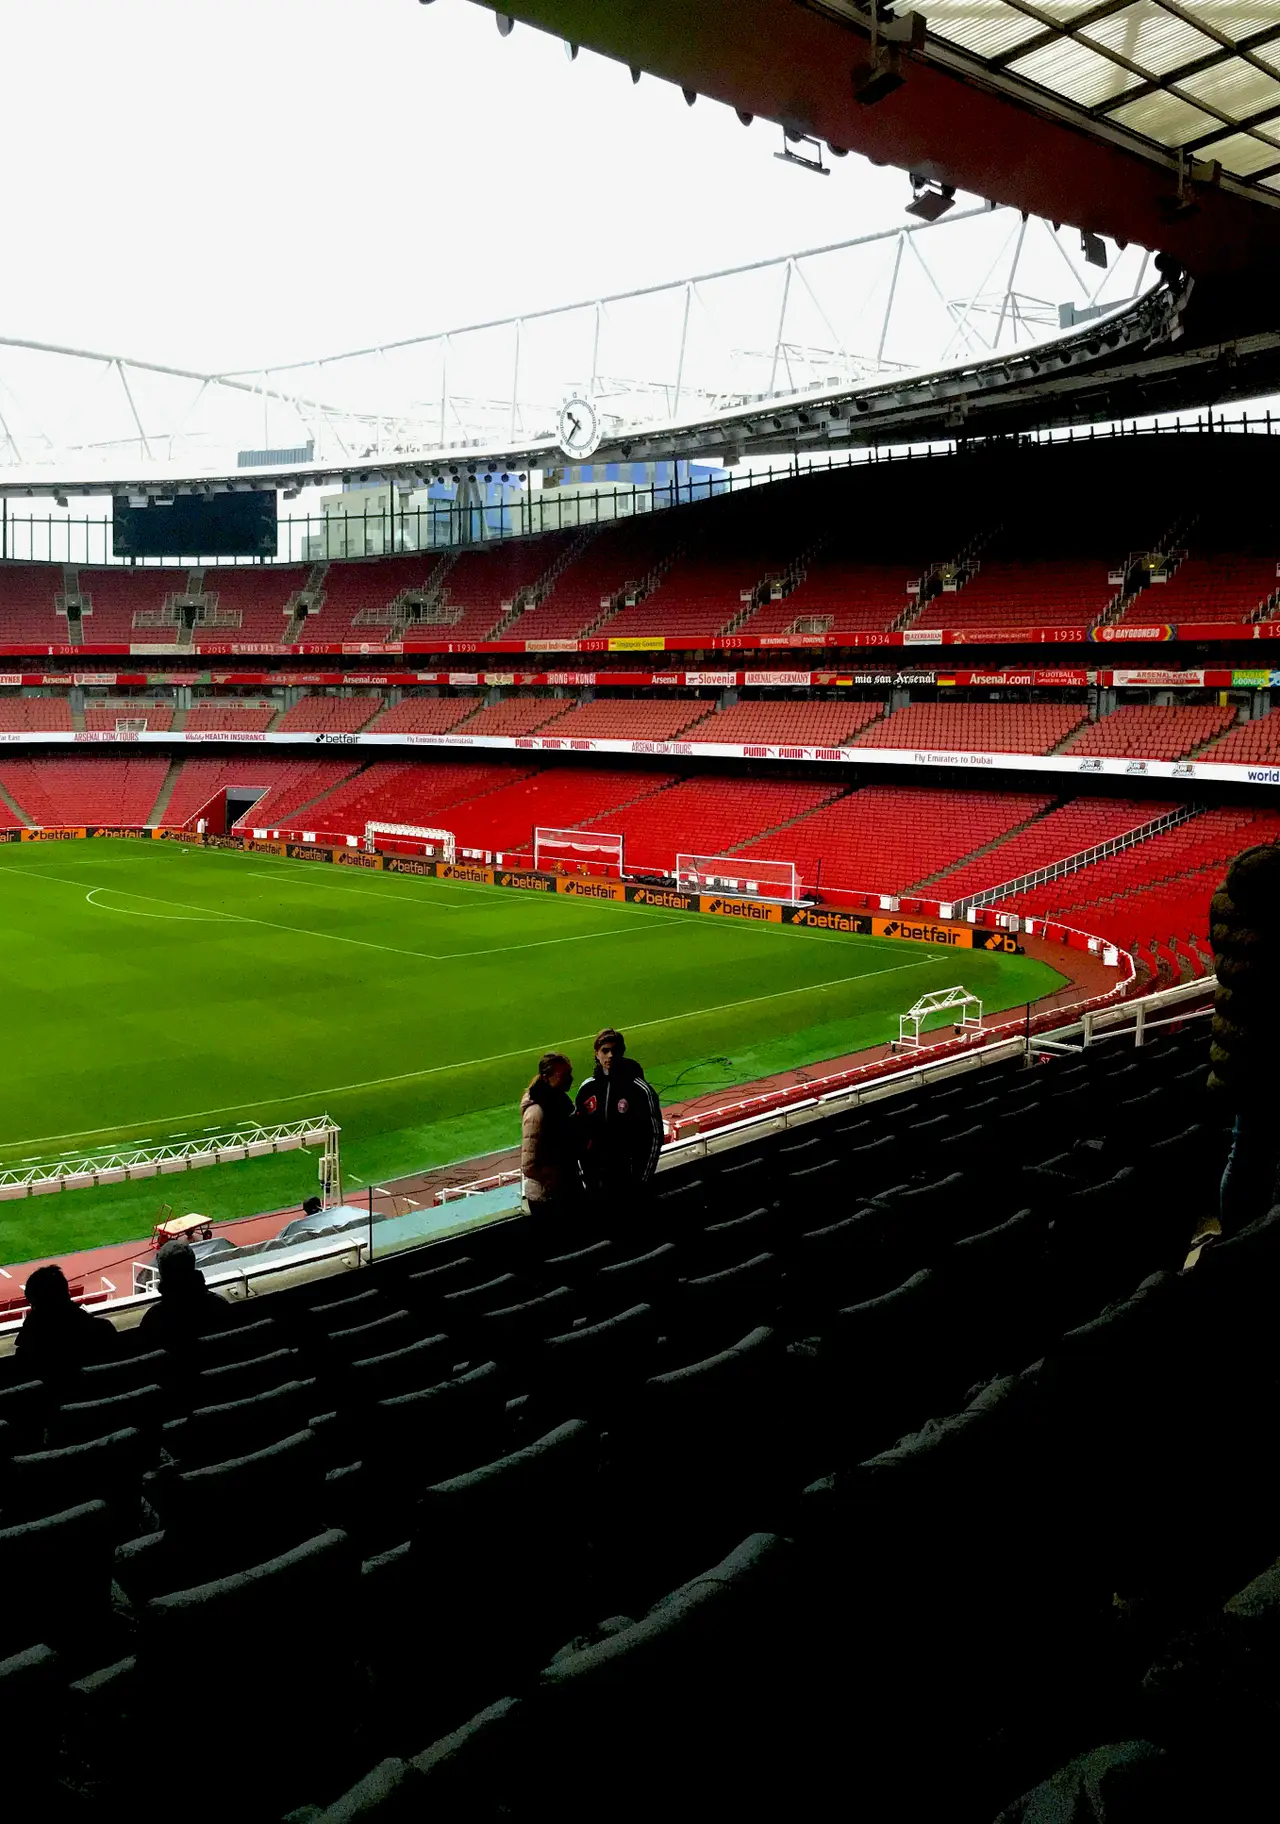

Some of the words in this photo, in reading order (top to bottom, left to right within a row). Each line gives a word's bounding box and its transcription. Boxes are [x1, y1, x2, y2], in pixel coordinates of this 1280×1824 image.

[865, 634, 890, 644] 1934
[1053, 630, 1083, 640] 1935
[586, 641, 605, 650] 1931
[720, 638, 742, 647] 1933
[457, 644, 476, 652] 1930
[42, 676, 72, 684] Arsenal
[343, 675, 388, 684] Arsenal.com
[651, 675, 678, 684] Arsenal
[698, 673, 735, 685] Slovenia
[747, 673, 773, 683] ARSENAL
[779, 673, 809, 683] GERMANY
[855, 674, 872, 684] mia
[873, 675, 892, 684] san
[970, 673, 1030, 684] Arsenal.com
[326, 734, 360, 743] betfair
[515, 739, 533, 748] PUMA
[542, 739, 560, 748] PUMA
[570, 740, 589, 749] PUMA
[743, 746, 767, 757] PUMA
[779, 748, 803, 758] PUMA
[815, 749, 841, 760] PUMA
[915, 754, 925, 763] Fly
[928, 754, 958, 763] Emirates
[971, 755, 993, 764] Dubai
[41, 830, 76, 840] betfair
[256, 841, 282, 854] betfair
[299, 849, 327, 861] betfair
[347, 853, 377, 867] betfair
[397, 860, 431, 874] betfair
[452, 867, 487, 882] betfair
[512, 874, 550, 891] betfair
[576, 881, 617, 899] betfair
[646, 889, 691, 909] betfair
[722, 900, 772, 919] betfair
[806, 909, 861, 932] betfair
[900, 918, 960, 945] betfair
